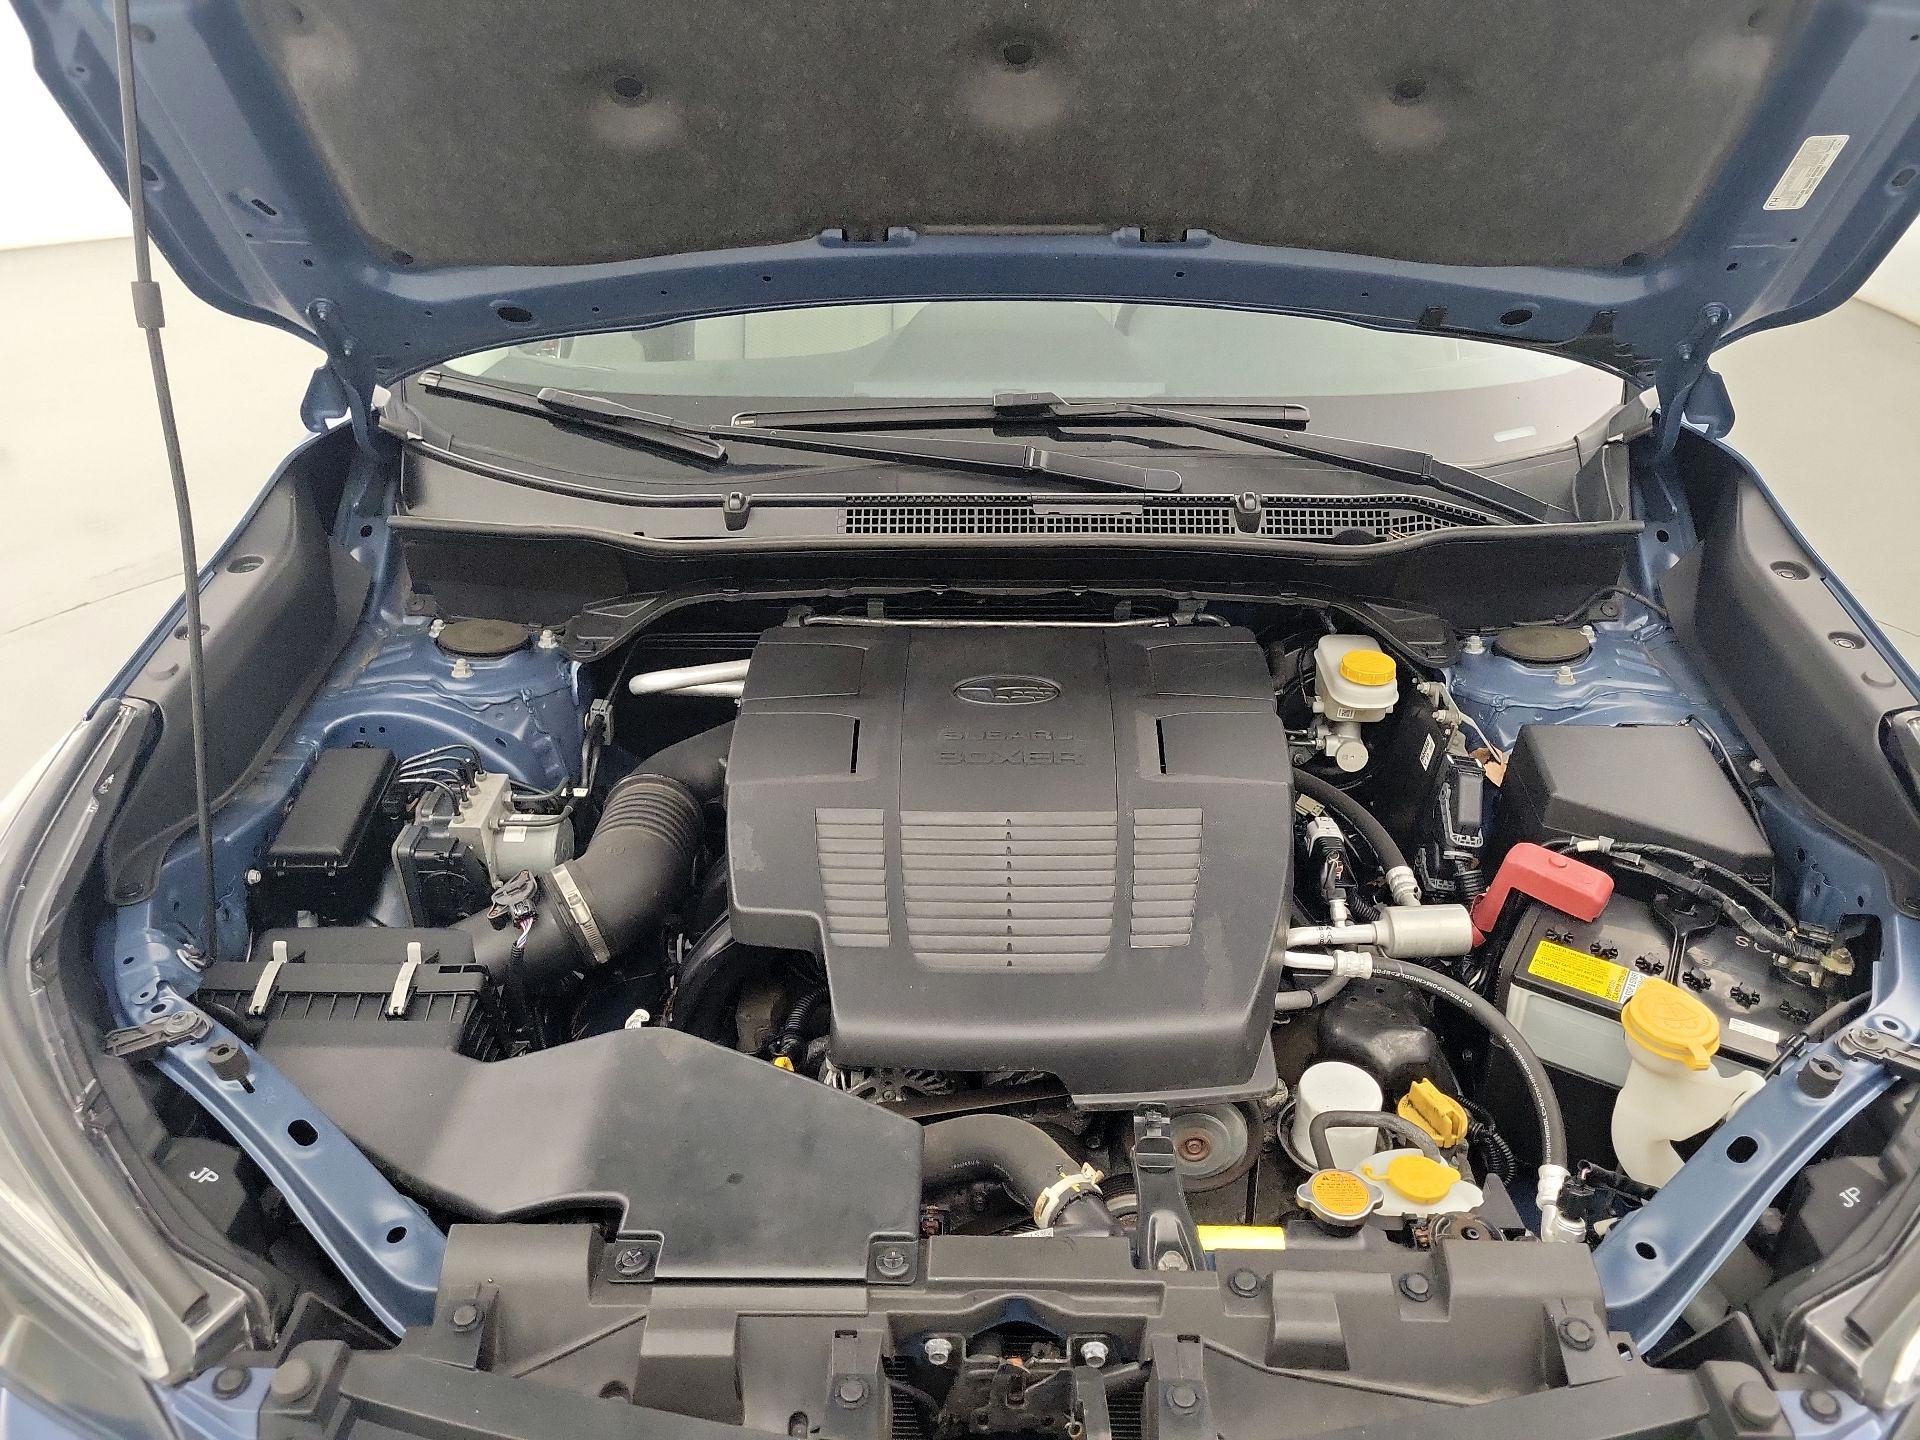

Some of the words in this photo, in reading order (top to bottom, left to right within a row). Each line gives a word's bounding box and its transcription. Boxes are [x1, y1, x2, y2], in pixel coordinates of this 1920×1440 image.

[940, 730, 1077, 743] SUBARU
[938, 750, 1086, 766] BOXER
[189, 1167, 219, 1183] JP
[1839, 1187, 1861, 1208] JP
